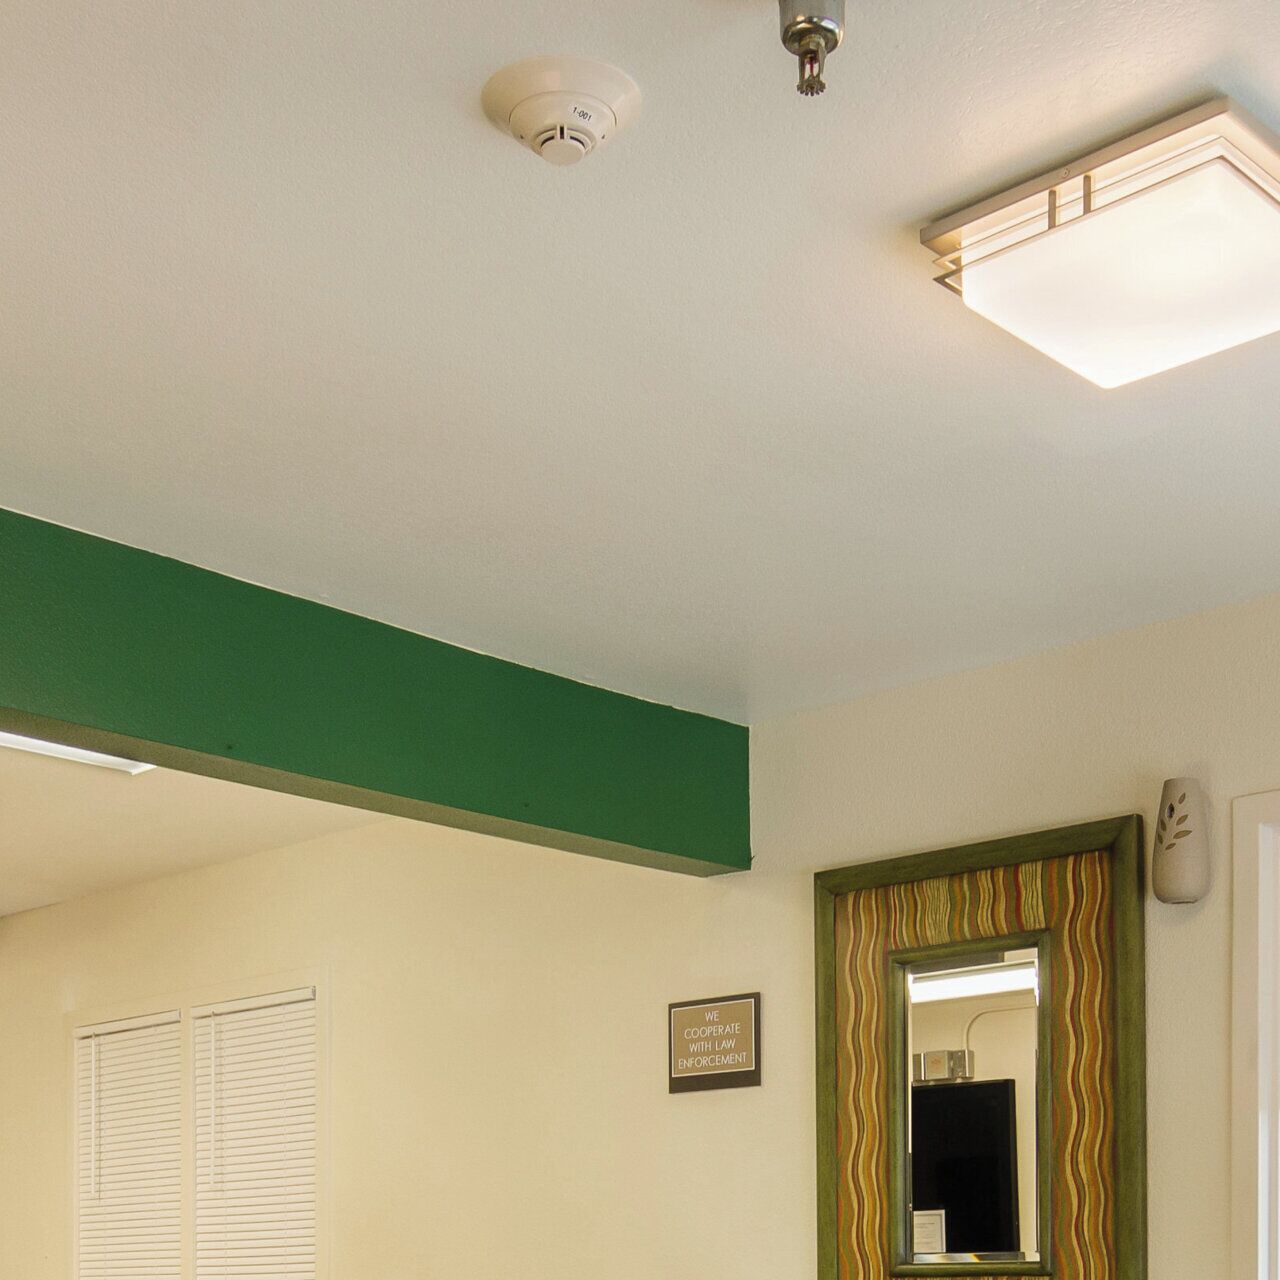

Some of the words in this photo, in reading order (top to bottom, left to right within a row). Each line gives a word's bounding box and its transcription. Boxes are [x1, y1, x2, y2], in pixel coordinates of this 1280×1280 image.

[705, 1010, 719, 1021] WE
[684, 1023, 741, 1040] COOPERATE
[689, 1041, 712, 1053] WITH
[715, 1038, 736, 1051] LAW
[678, 1052, 747, 1070] ENFORCEMENT
